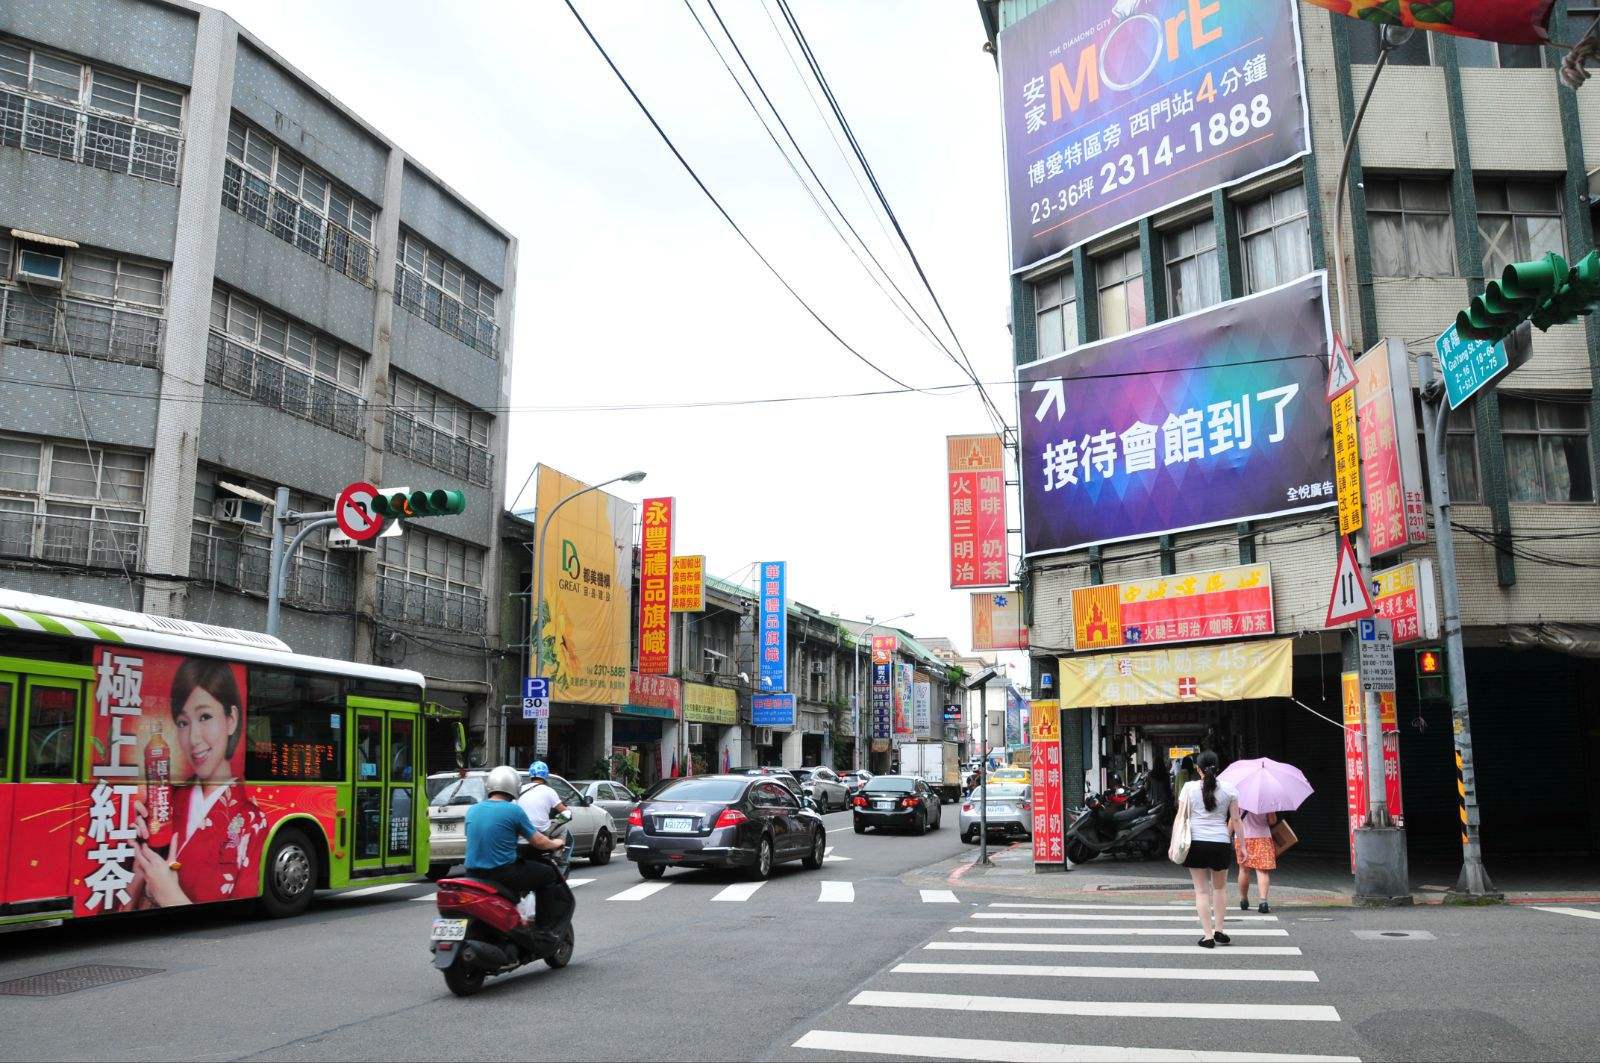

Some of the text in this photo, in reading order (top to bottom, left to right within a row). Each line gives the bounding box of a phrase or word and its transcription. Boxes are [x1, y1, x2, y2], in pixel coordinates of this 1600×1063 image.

[1063, 26, 1096, 51] DIAMOND
[1096, 17, 1112, 34] CITY
[1023, 76, 1047, 134] 安家
[1028, 54, 1270, 188] 博愛特區旁 西門站4分鐘
[1030, 93, 1272, 225] 23-36坪 2314-1888
[1042, 382, 1300, 492] 接待會館到了
[1362, 410, 1386, 548] 火腿三明治
[952, 476, 975, 582] 火腿三明治
[1287, 481, 1334, 502] 全悅廣告
[558, 578, 582, 593] GREAT
[641, 501, 669, 655] 永豐禮品旗幟
[1362, 621, 1374, 640] P
[524, 698, 543, 708] 30
[527, 678, 546, 698] P
[85, 652, 144, 910] 極上紅茶
[1033, 746, 1048, 858] 火腿三明治
